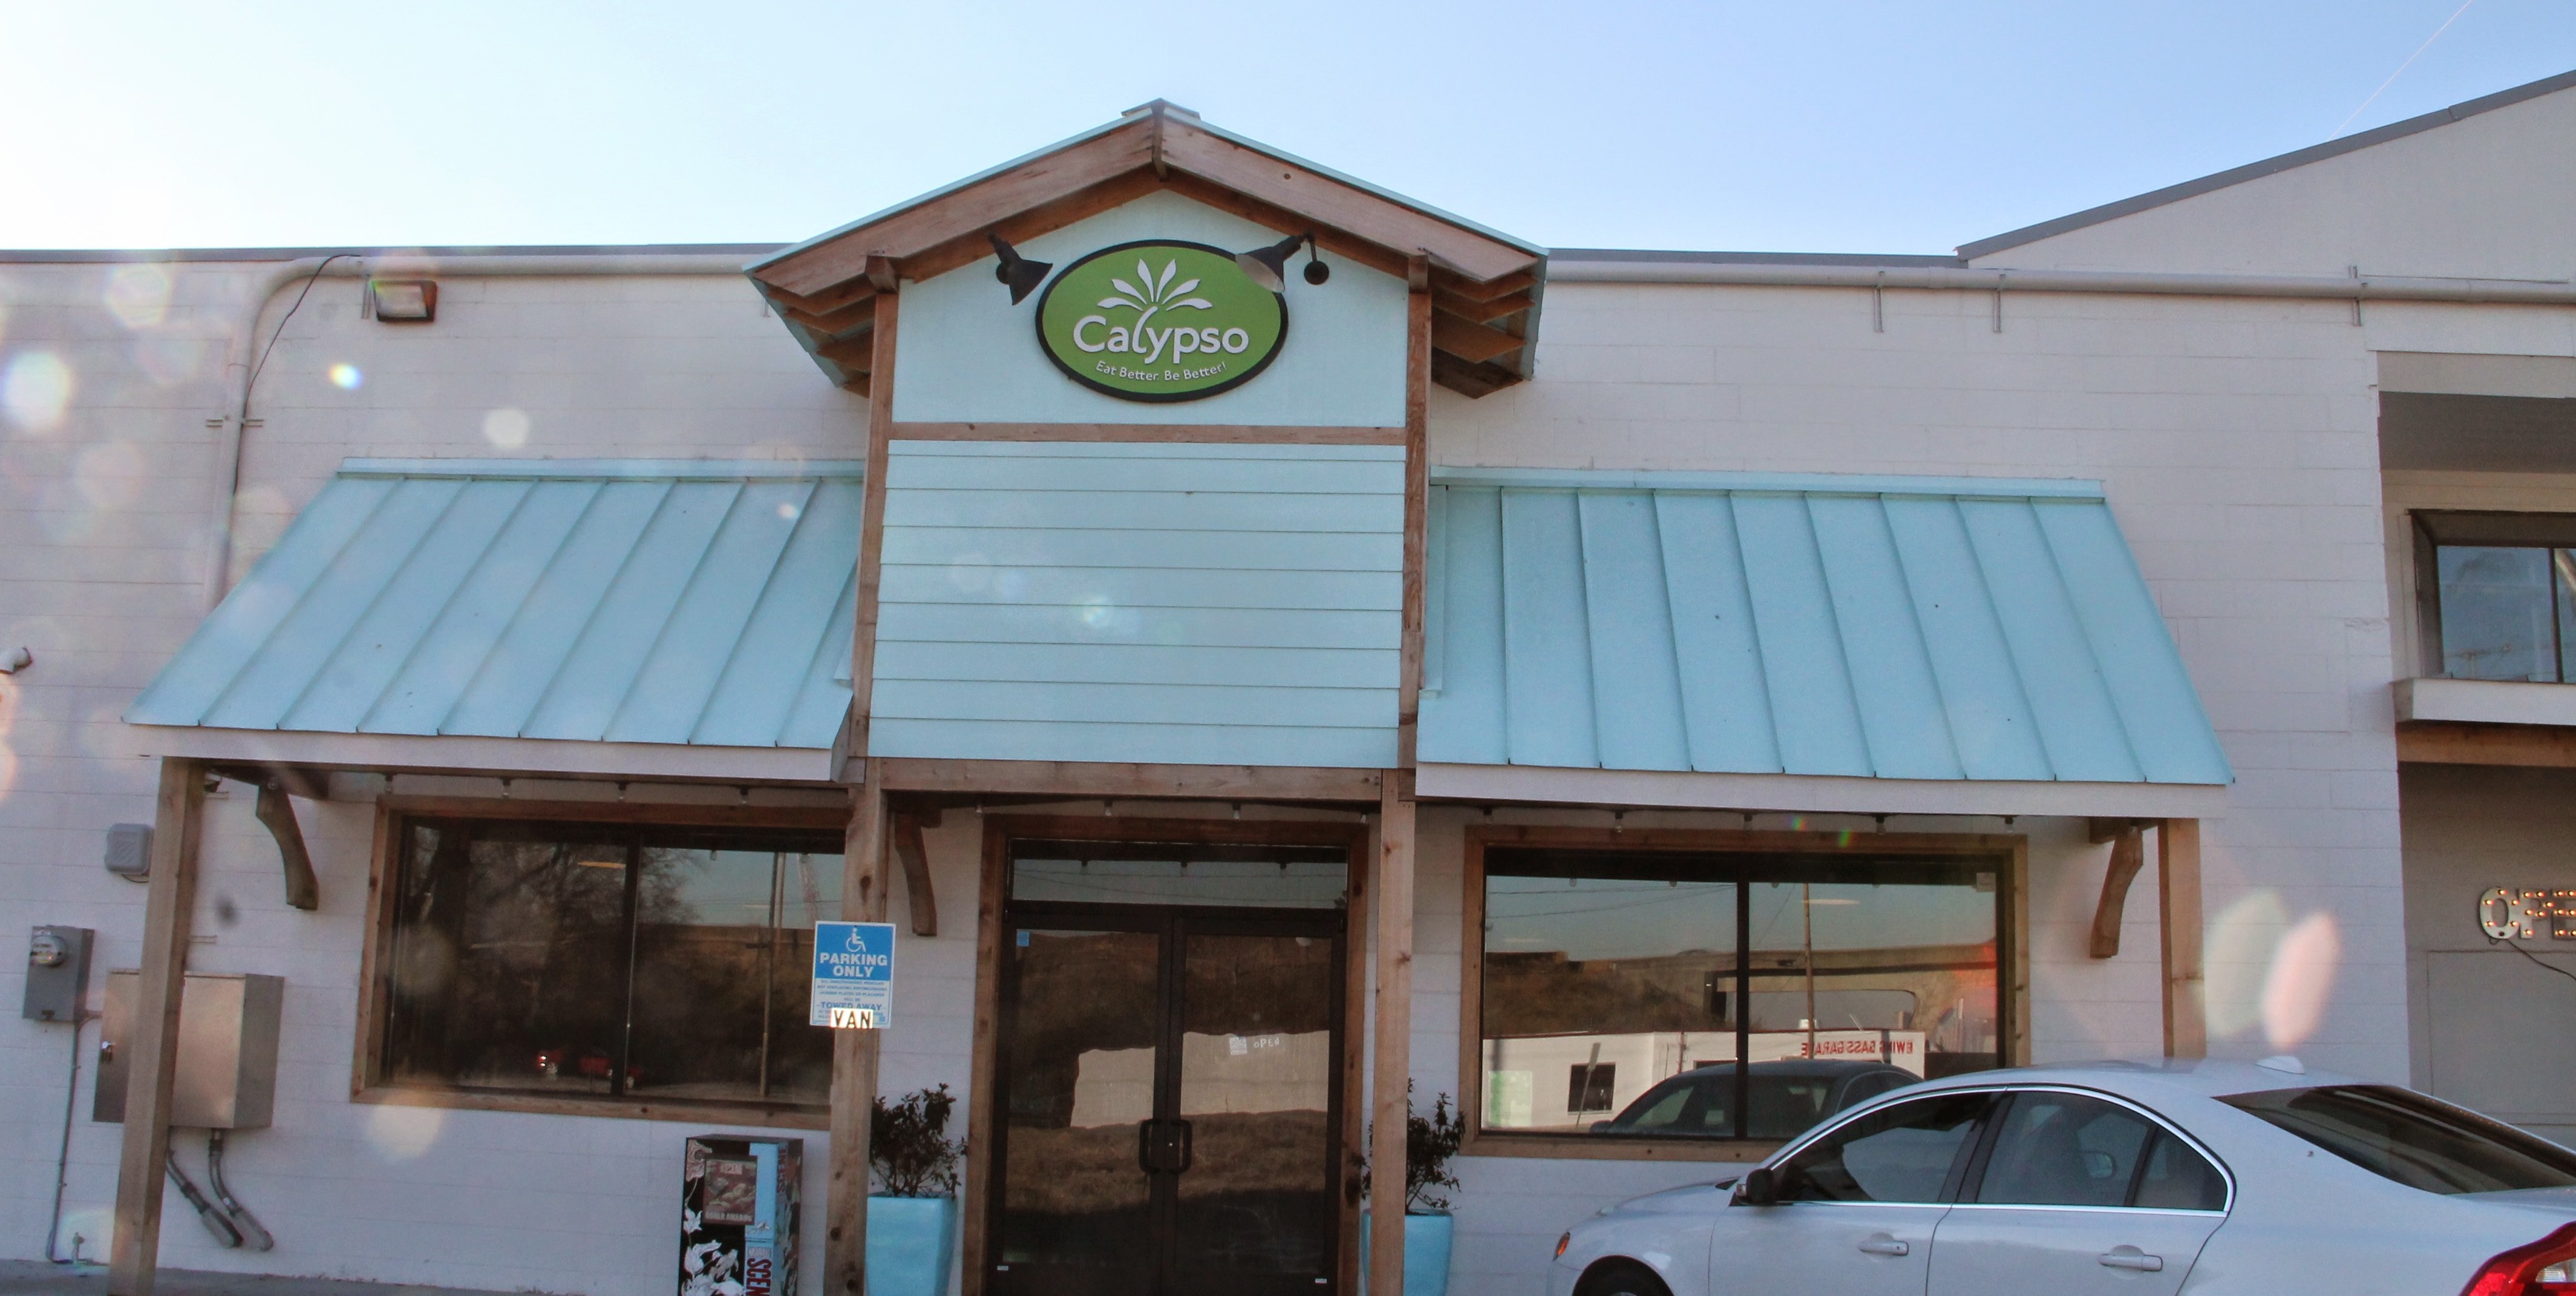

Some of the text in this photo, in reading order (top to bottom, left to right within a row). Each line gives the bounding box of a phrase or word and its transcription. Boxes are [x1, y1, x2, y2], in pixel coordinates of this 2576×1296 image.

[1073, 306, 1249, 364] Calypso
[1096, 361, 1117, 375] Eat
[1165, 370, 1180, 381] Be
[1183, 361, 1227, 379] Better!
[820, 952, 888, 966] PARKING
[832, 966, 874, 978] ONLY
[834, 1010, 871, 1028] VAN
